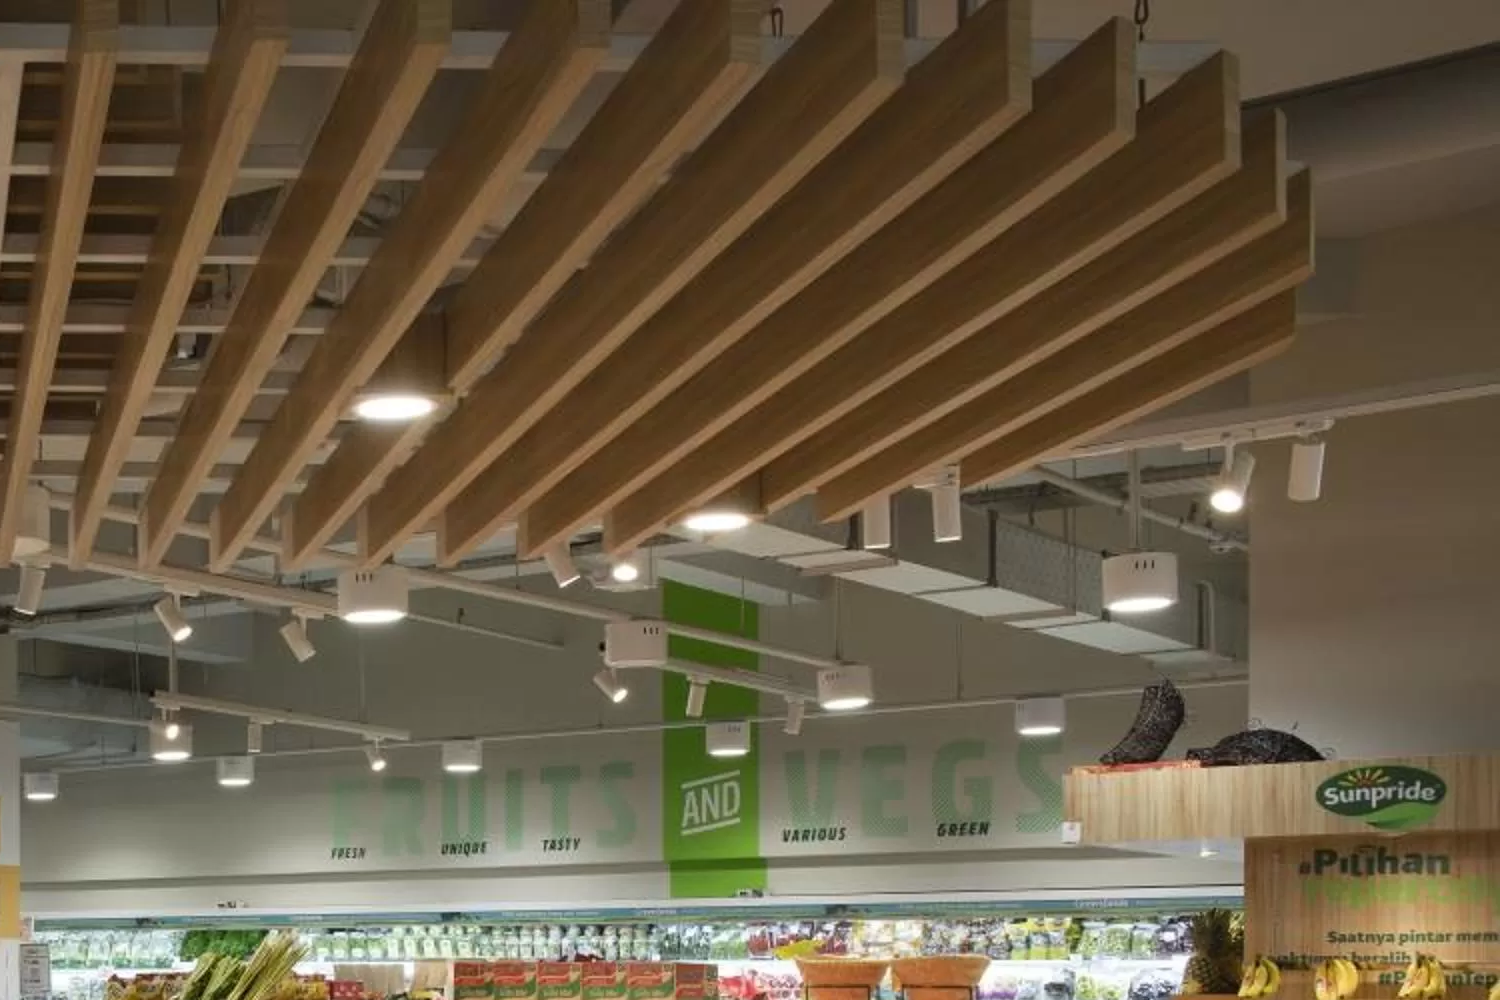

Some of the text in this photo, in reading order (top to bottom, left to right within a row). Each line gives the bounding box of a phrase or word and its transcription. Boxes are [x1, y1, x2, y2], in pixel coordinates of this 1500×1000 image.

[784, 737, 1064, 839] VEGS
[1323, 781, 1436, 808] Sunpride
[329, 761, 637, 857] FRUITS
[681, 779, 740, 829] AND
[782, 827, 847, 843] VARIOUS
[936, 821, 990, 837] GREEN
[441, 841, 487, 857] UNIQUE
[542, 837, 580, 852] TASTY
[1327, 930, 1395, 946] Saatnya
[1399, 929, 1451, 946] pintar
